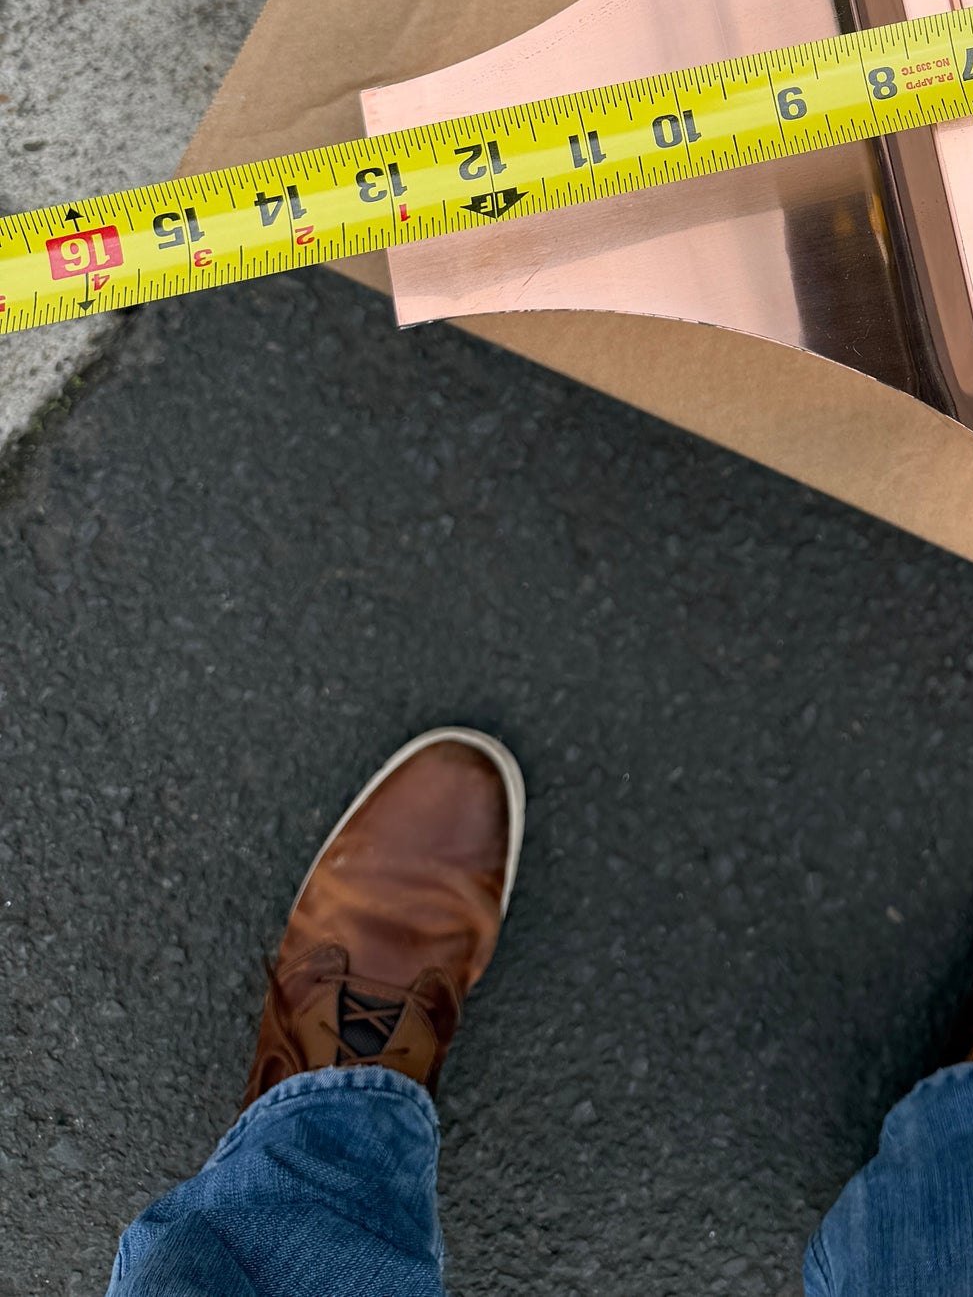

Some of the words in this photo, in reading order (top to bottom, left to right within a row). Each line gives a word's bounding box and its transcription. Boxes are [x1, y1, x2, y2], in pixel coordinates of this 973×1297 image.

[933, 58, 951, 69] NO.
[935, 72, 954, 85] P.R.
[868, 66, 898, 100] 8
[905, 76, 934, 90] APP'D
[777, 86, 808, 121] 9
[652, 110, 702, 149] 10
[454, 140, 508, 181] 12
[568, 130, 607, 169] 11
[355, 162, 409, 203] 13
[254, 184, 308, 227] 14
[399, 203, 411, 222] 1
[480, 192, 507, 213] 1F
[152, 207, 206, 250] 15
[295, 225, 315, 245] 2
[60, 232, 111, 272] 16
[193, 249, 213, 268] 3
[91, 273, 111, 291] 4
